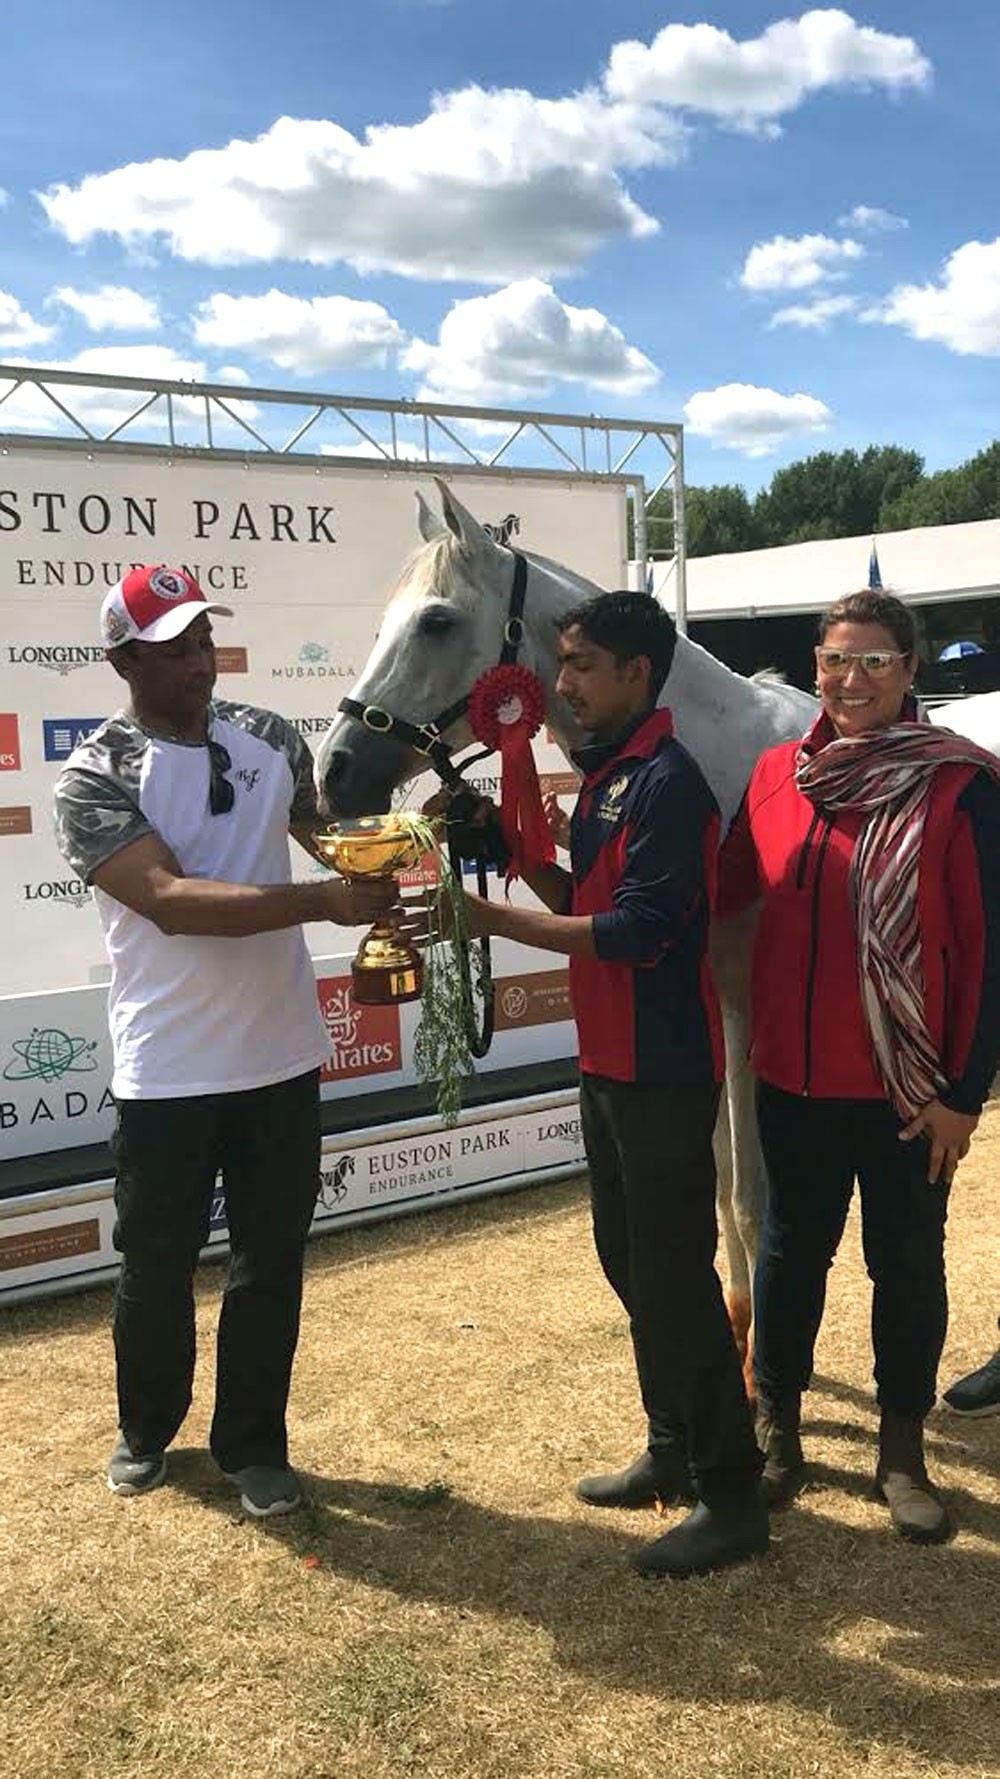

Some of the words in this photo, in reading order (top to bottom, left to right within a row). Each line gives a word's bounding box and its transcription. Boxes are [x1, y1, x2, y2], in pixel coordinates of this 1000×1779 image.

[193, 501, 337, 543] PARK
[16, 559, 248, 590] ENDUNCE
[271, 666, 355, 678] MUBADALA
[0, 1086, 116, 1129] BADA
[368, 1140, 452, 1176] EUSTON
[460, 1129, 511, 1156] PARK
[368, 1165, 454, 1195] ENDURANCE
